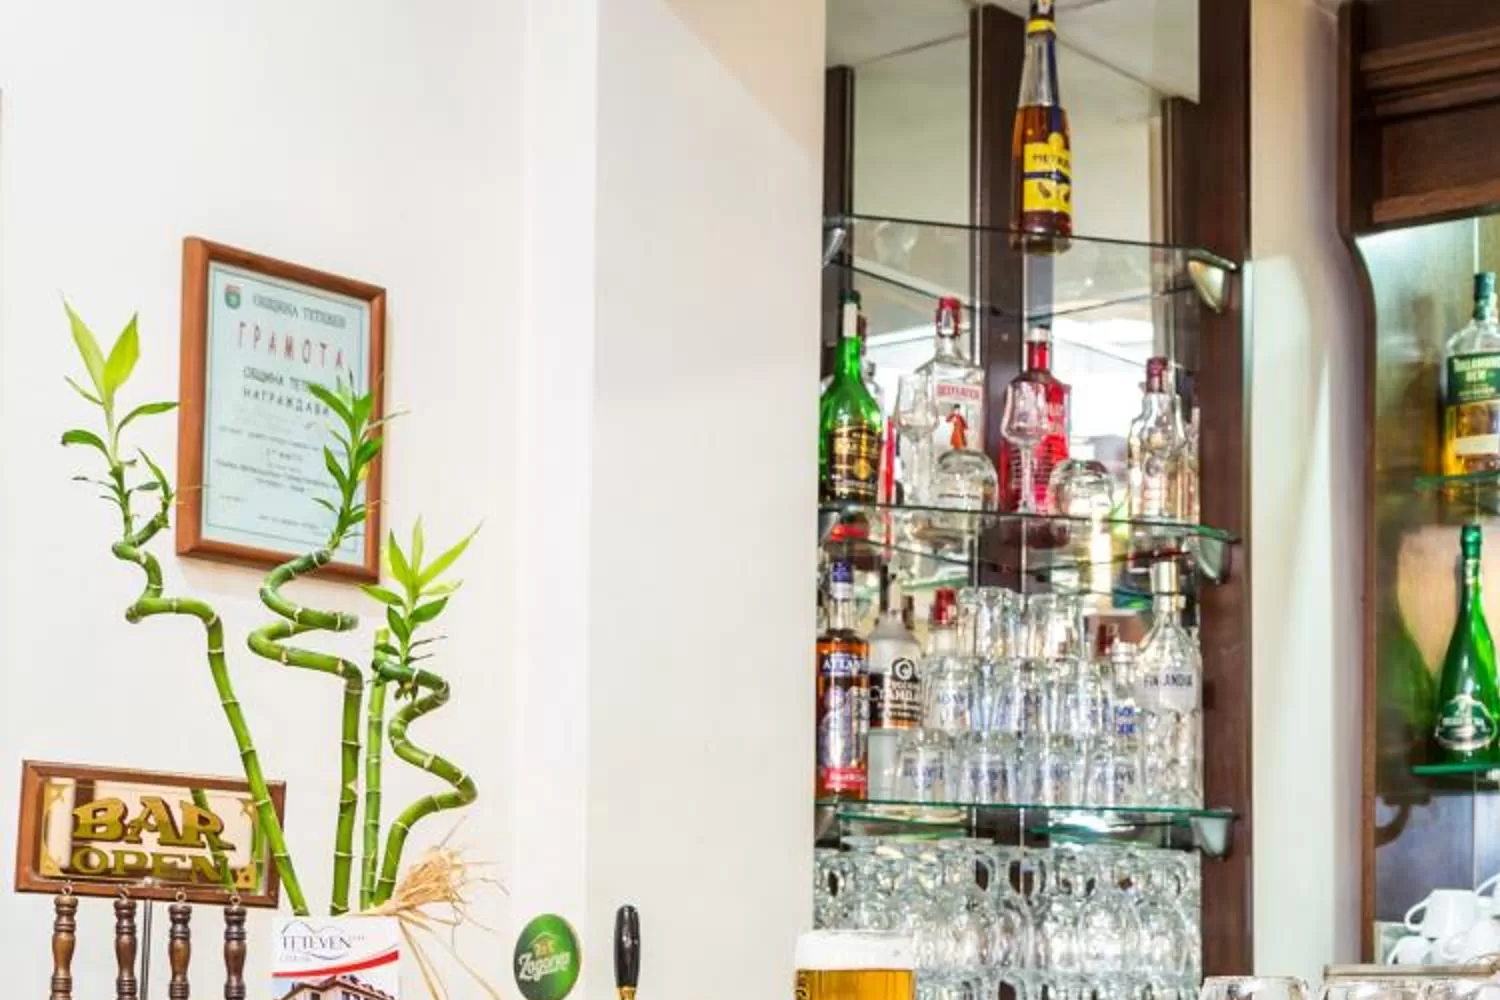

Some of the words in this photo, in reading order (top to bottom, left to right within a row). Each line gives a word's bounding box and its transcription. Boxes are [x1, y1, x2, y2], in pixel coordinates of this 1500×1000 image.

[238, 321, 344, 369] ГРАМОТА
[72, 795, 236, 850] BAR
[69, 845, 229, 884] OPEN
